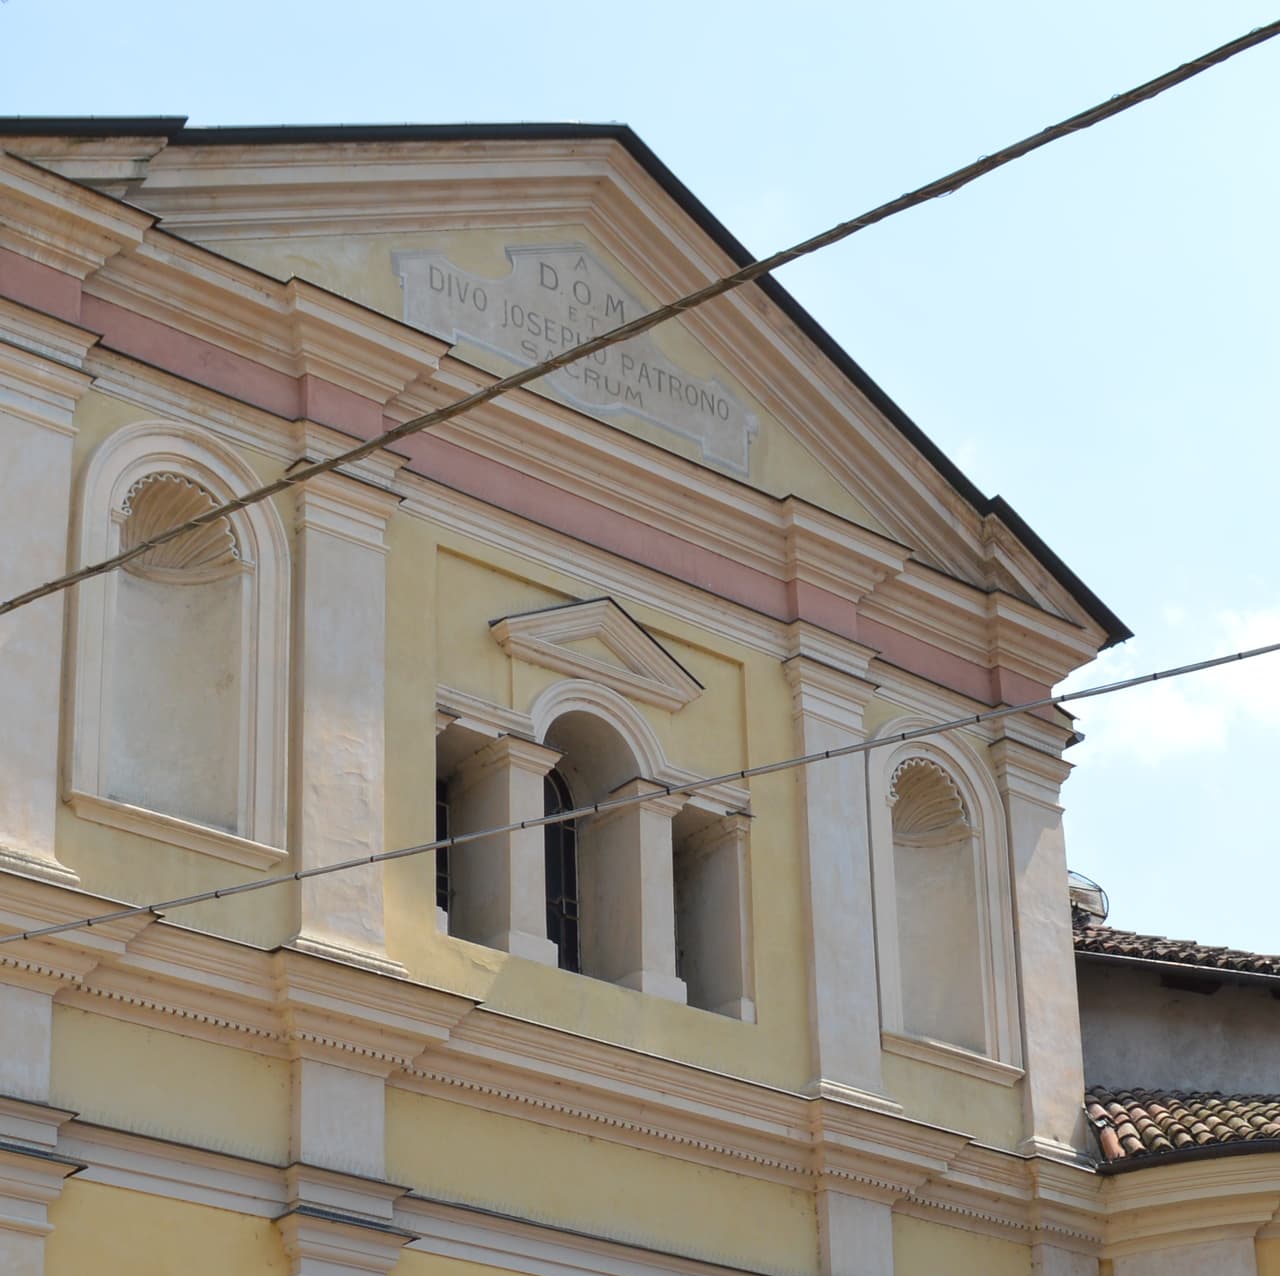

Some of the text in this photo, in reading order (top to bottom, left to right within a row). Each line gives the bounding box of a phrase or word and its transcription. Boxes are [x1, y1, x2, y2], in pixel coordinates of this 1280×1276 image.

[429, 264, 488, 312] DIVO
[621, 352, 729, 421] PATRONO
[568, 306, 598, 331] ET
